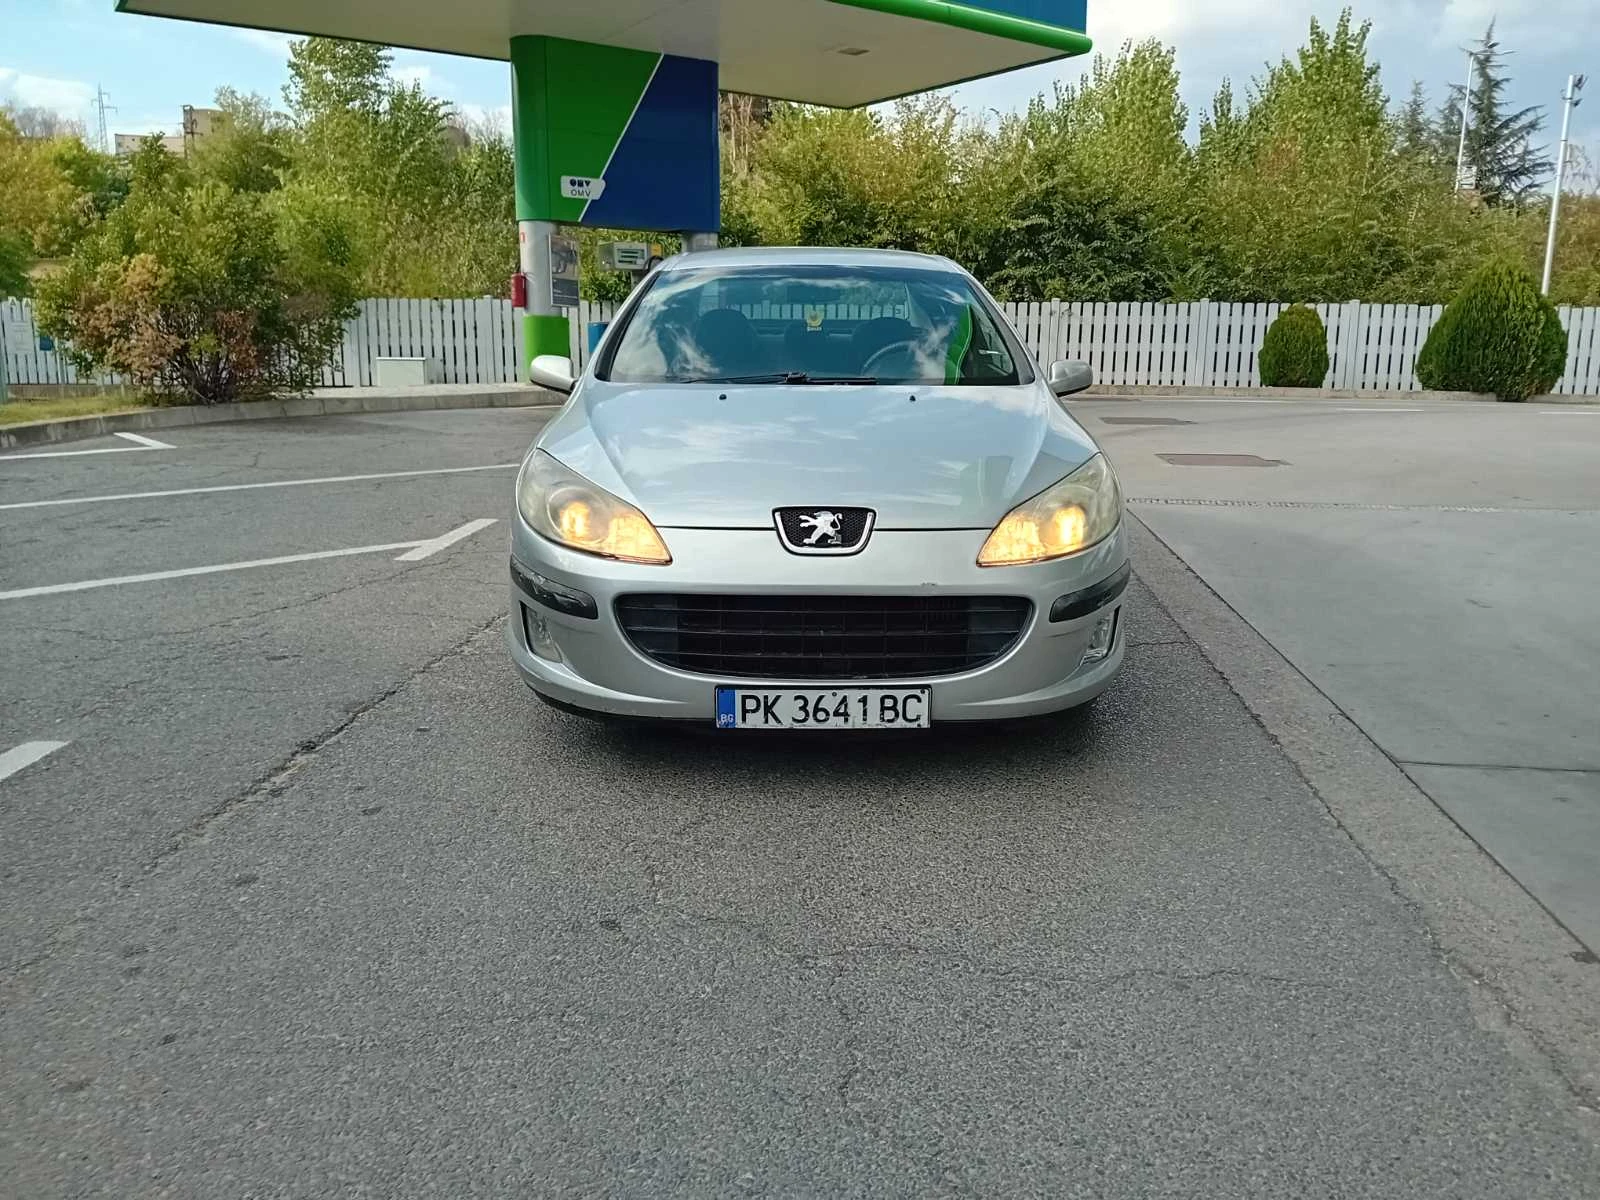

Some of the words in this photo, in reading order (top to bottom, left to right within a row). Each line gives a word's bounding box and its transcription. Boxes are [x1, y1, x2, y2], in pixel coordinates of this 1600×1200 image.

[571, 189, 591, 197] OMV
[740, 694, 783, 724] PK
[720, 713, 734, 723] BG
